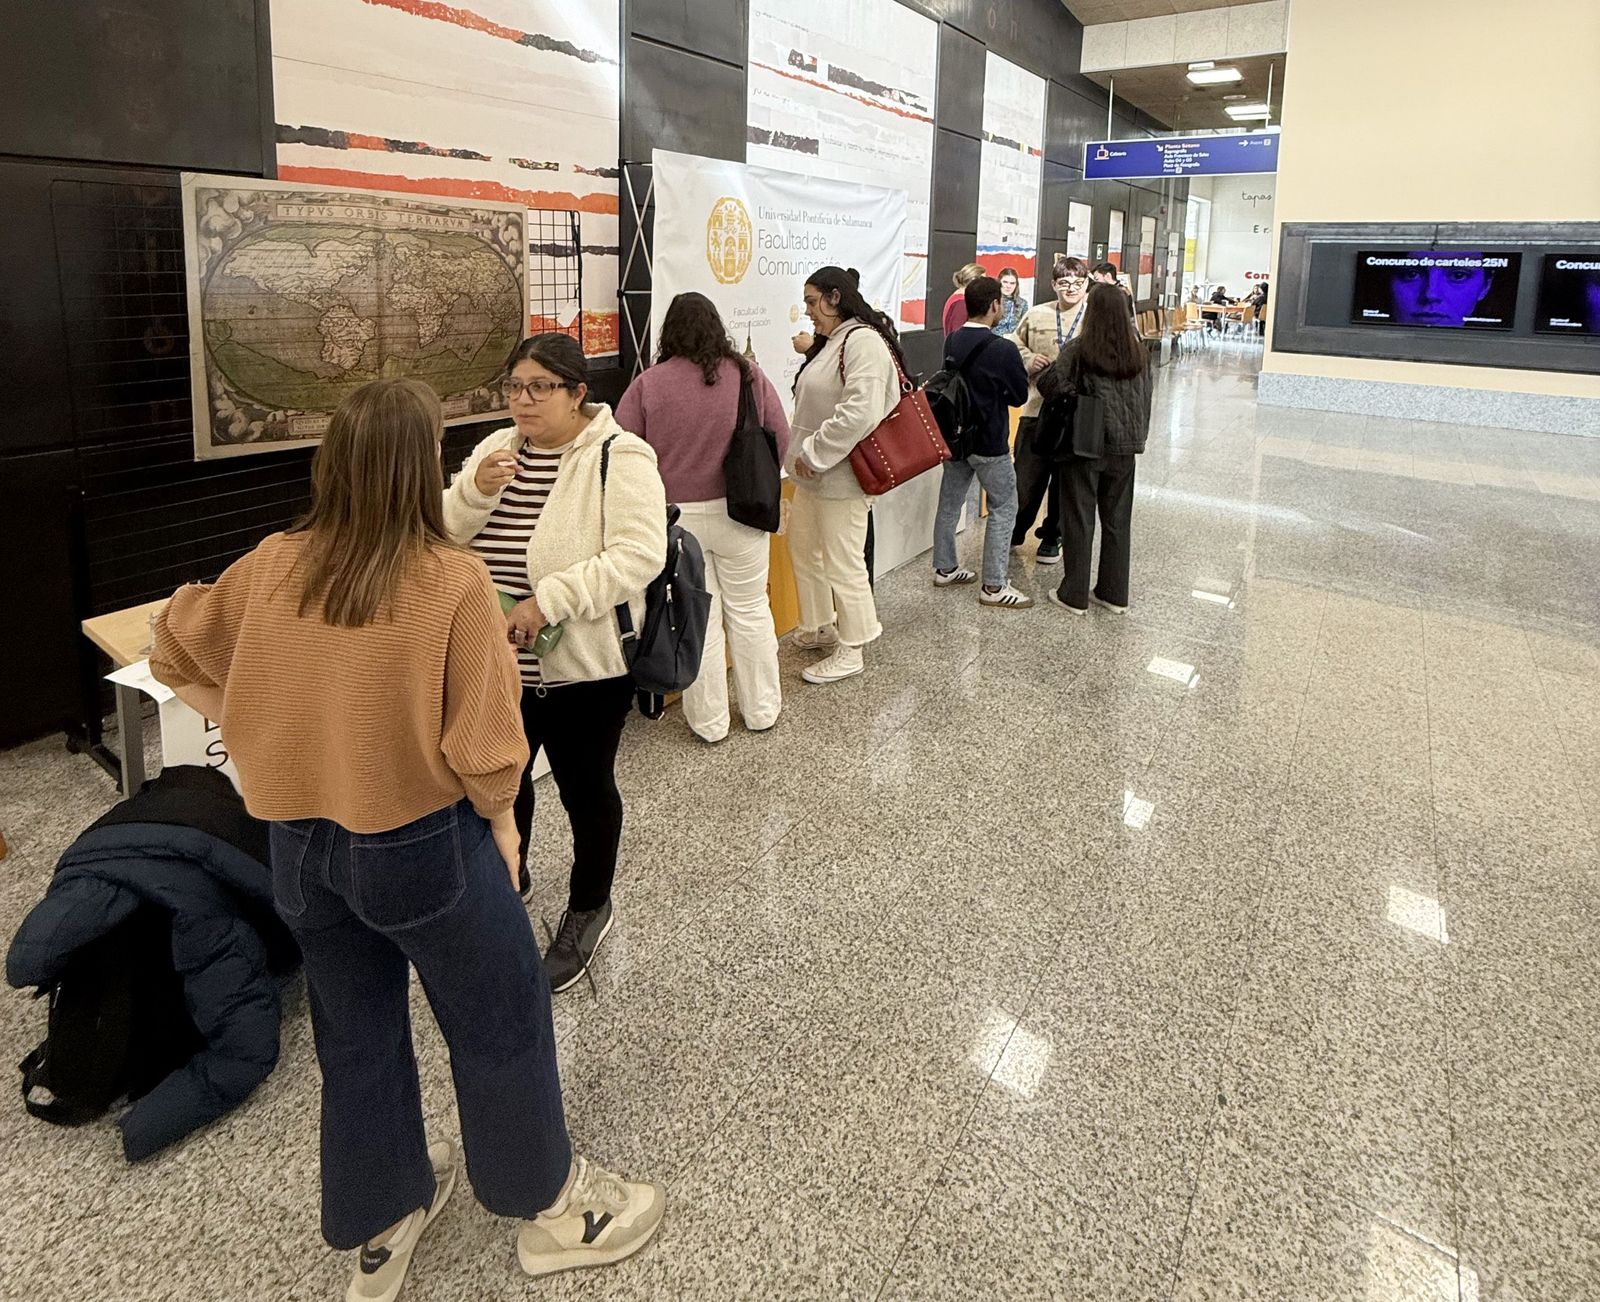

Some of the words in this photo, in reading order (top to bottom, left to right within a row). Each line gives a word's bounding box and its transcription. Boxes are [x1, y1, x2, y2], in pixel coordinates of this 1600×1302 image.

[1242, 191, 1272, 208] tapas
[282, 206, 334, 217] TYPVS
[343, 207, 388, 221] ORBIS
[398, 212, 466, 229] TERRARVM
[758, 206, 801, 222] Universidad
[802, 210, 832, 226] Pontificia
[833, 214, 841, 225] de
[841, 214, 873, 229] Salamanca
[758, 228, 809, 250] Facultad
[811, 231, 827, 251] de
[1366, 256, 1419, 267] Concurso
[1419, 257, 1435, 267] de
[1435, 257, 1482, 268] carteles
[1482, 257, 1509, 268] 25N
[1244, 271, 1270, 280] Con
[733, 305, 759, 317] Facultad
[759, 307, 768, 316] de
